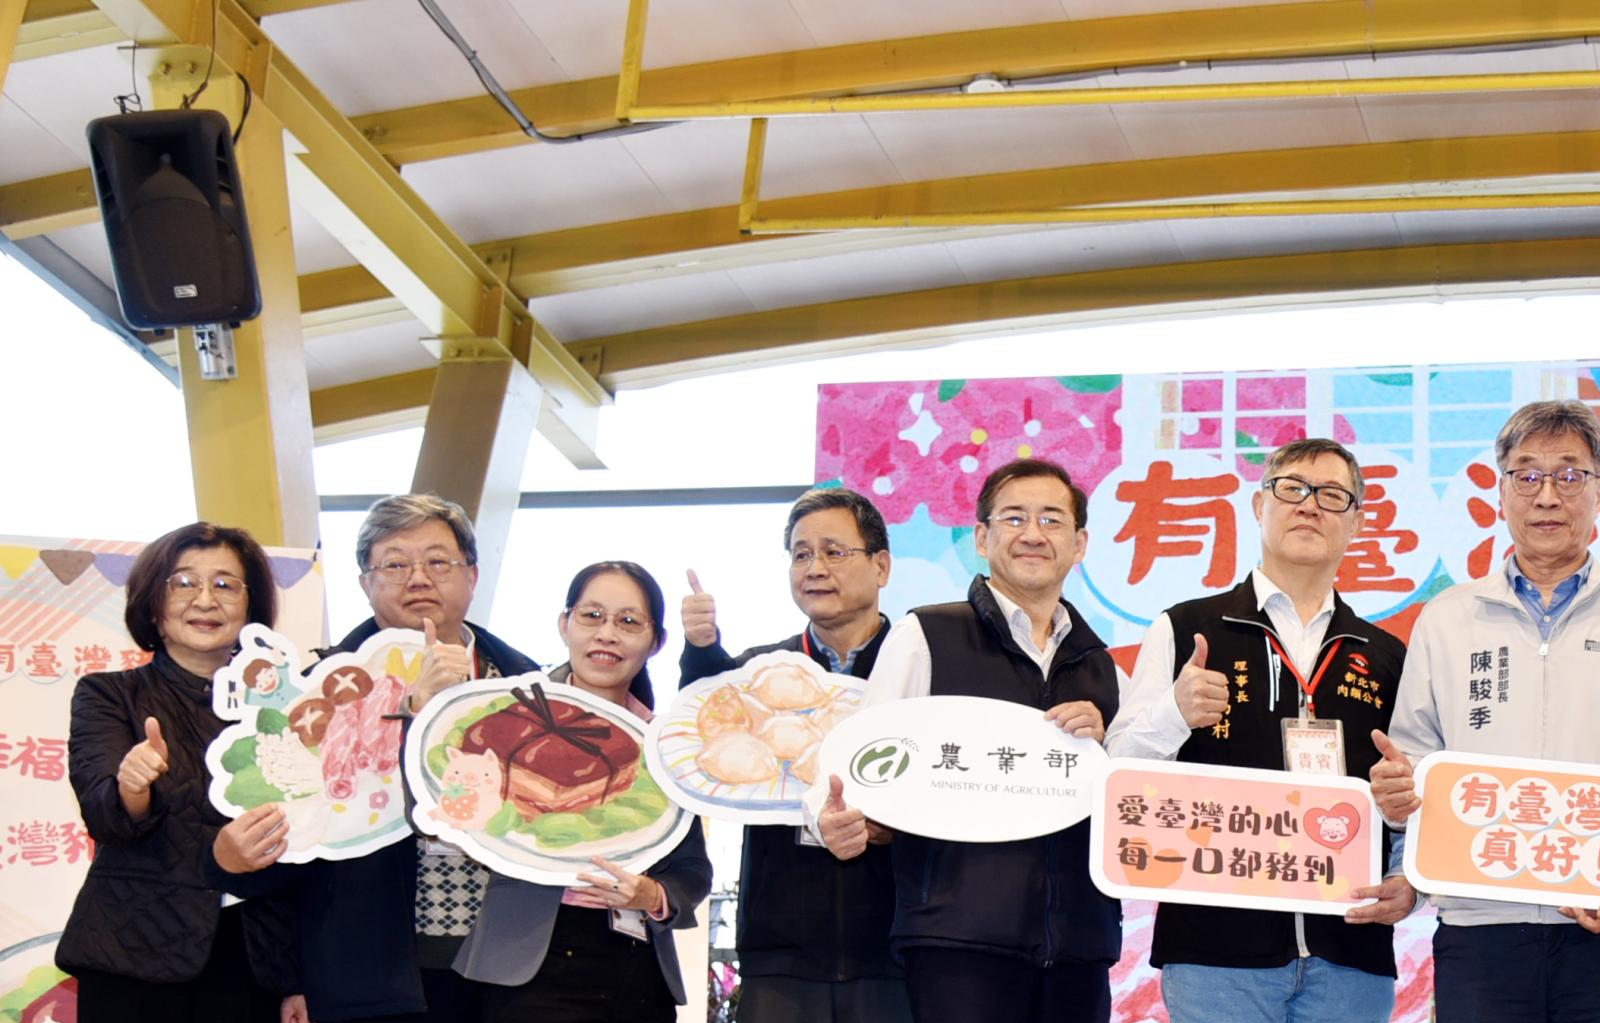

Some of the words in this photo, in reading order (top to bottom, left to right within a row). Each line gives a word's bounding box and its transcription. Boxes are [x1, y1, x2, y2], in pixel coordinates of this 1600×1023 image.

[1233, 661, 1250, 704] 理事長
[1344, 672, 1381, 692] 新北市
[1469, 650, 1493, 730] 陳駿季
[1498, 646, 1509, 703] 農業部部長
[1337, 684, 1385, 710] 肉類公會
[931, 742, 1079, 778] 農業部
[1299, 752, 1331, 770] 貴賓
[930, 780, 983, 793] MINISTRY
[984, 784, 1000, 793] OF
[1003, 785, 1079, 798] AGRICULTURE
[1116, 794, 1299, 838] 愛臺灣的心
[1116, 837, 1336, 886] 每一口都豬到
